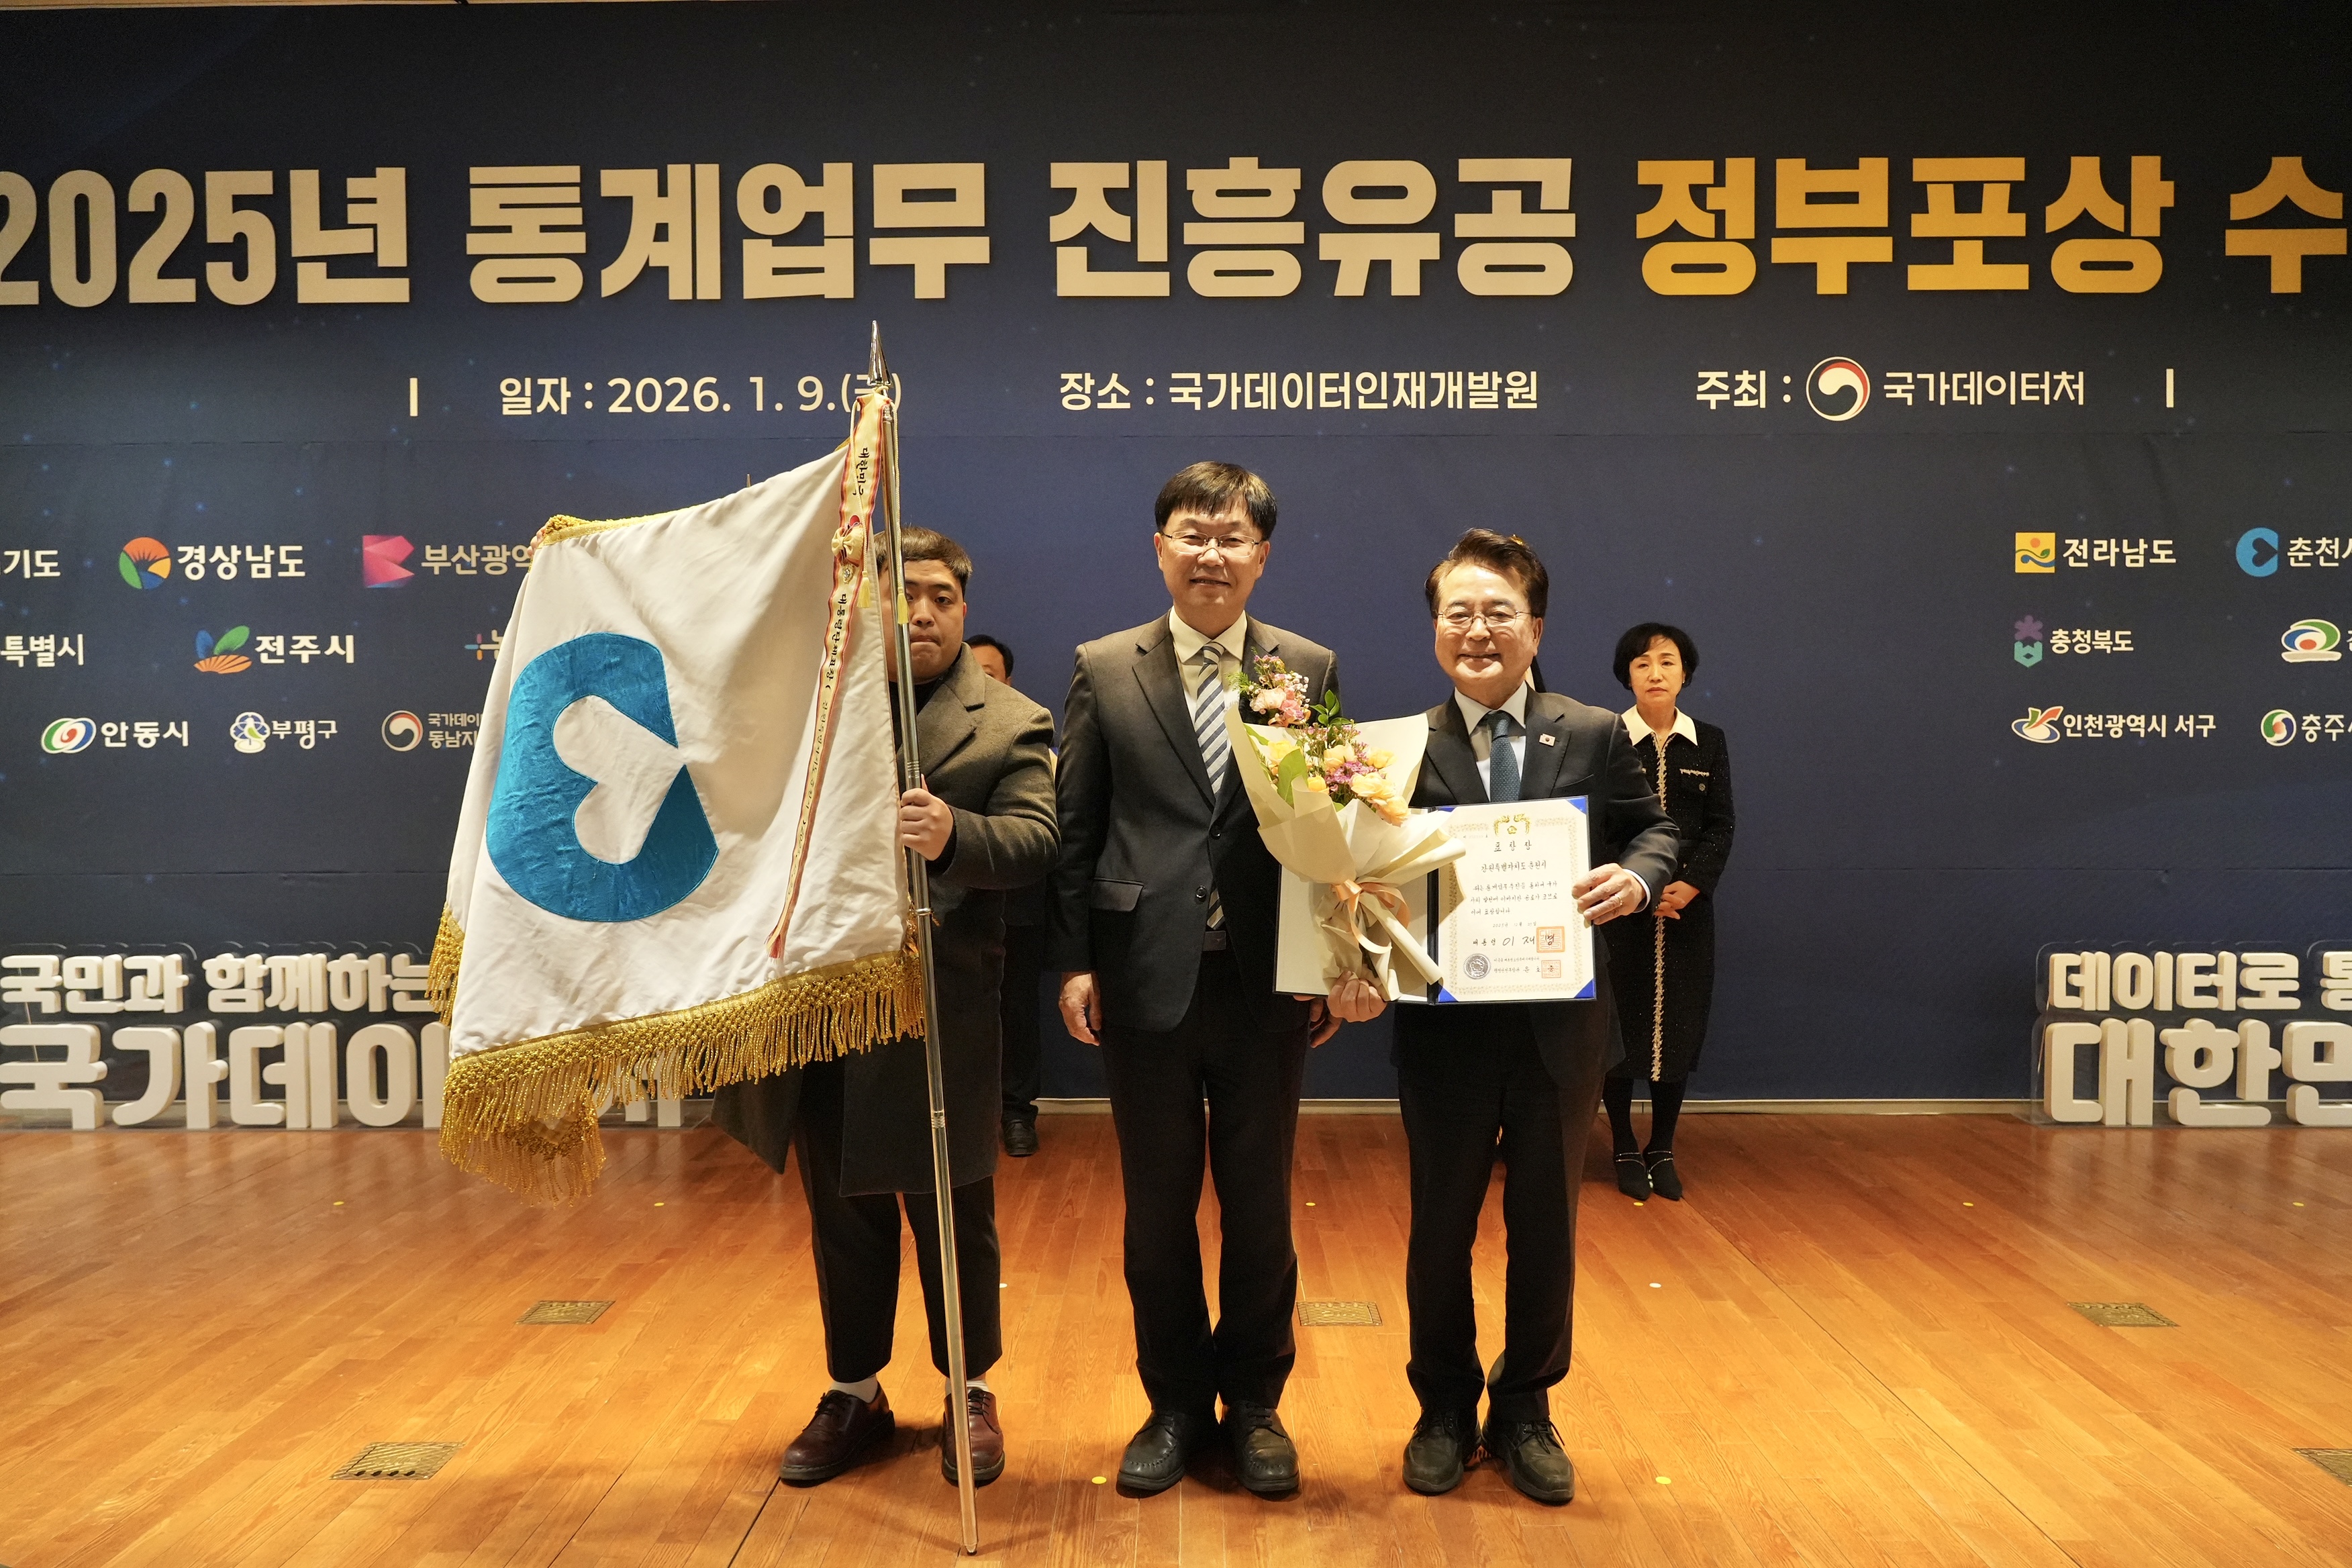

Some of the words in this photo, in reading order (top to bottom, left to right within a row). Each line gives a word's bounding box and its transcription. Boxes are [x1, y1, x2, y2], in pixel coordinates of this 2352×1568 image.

[0, 168, 409, 307] 2025년
[467, 162, 990, 303] 통계업무
[1050, 157, 1575, 297] 진흥유공
[1633, 156, 2175, 295] 정부포상
[607, 376, 731, 413] 2026.
[749, 376, 783, 411] 1.
[1060, 373, 1131, 411] 장소
[1169, 371, 1538, 410] 국가데이터인재개발원
[1696, 370, 1766, 410] 주최
[1883, 371, 2084, 406] 국가데이터처
[0, 549, 61, 579] 기도
[177, 545, 306, 581] 경상남도
[2063, 538, 2177, 568] 전라남도
[0, 634, 84, 668] 특별시
[254, 635, 354, 664] 전주시
[2049, 629, 2135, 654] 충청북도
[101, 720, 189, 748] 안동시
[271, 720, 338, 750] 부평구
[428, 713, 483, 727] 국가데이
[2063, 714, 2167, 738] 인천광역시
[2174, 714, 2216, 738] 서구
[1, 954, 189, 1014] 국민과
[2049, 950, 2301, 1011] 데이터로
